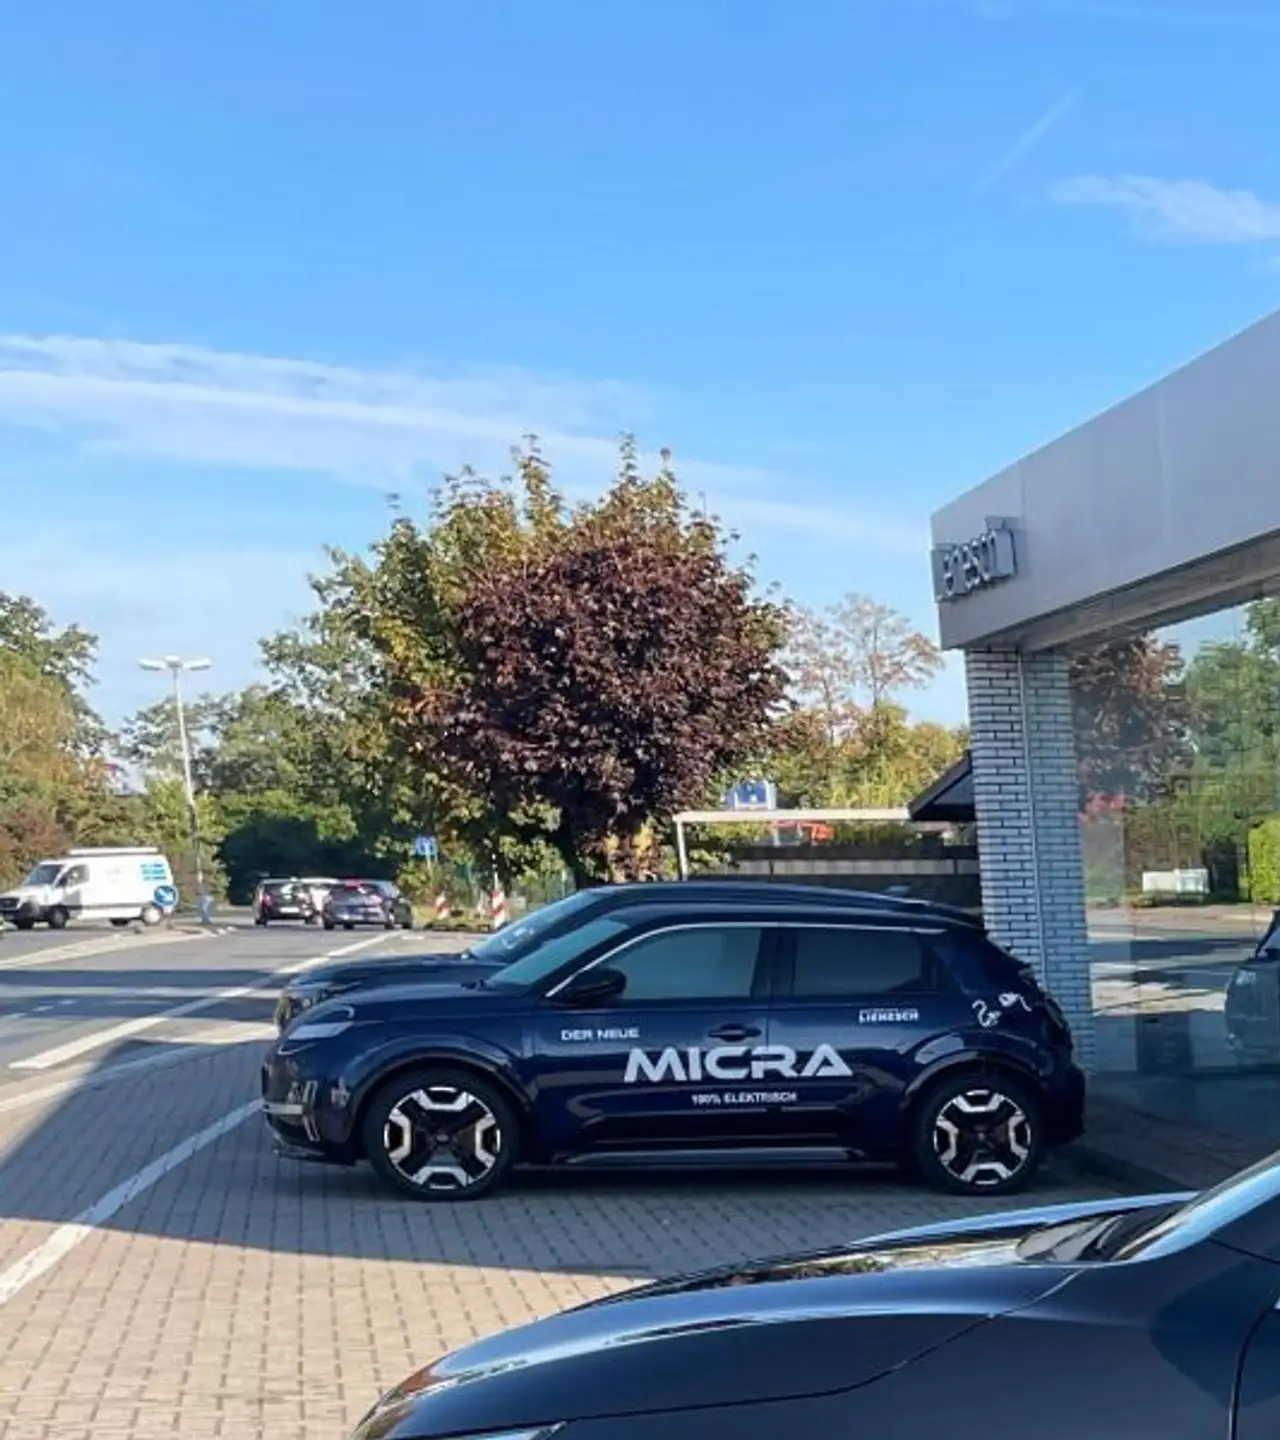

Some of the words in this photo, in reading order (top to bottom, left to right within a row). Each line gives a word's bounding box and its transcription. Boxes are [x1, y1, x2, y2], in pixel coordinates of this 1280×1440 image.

[561, 1029, 593, 1041] DER
[597, 1027, 639, 1041] NEUE
[623, 1043, 854, 1083] MICRA
